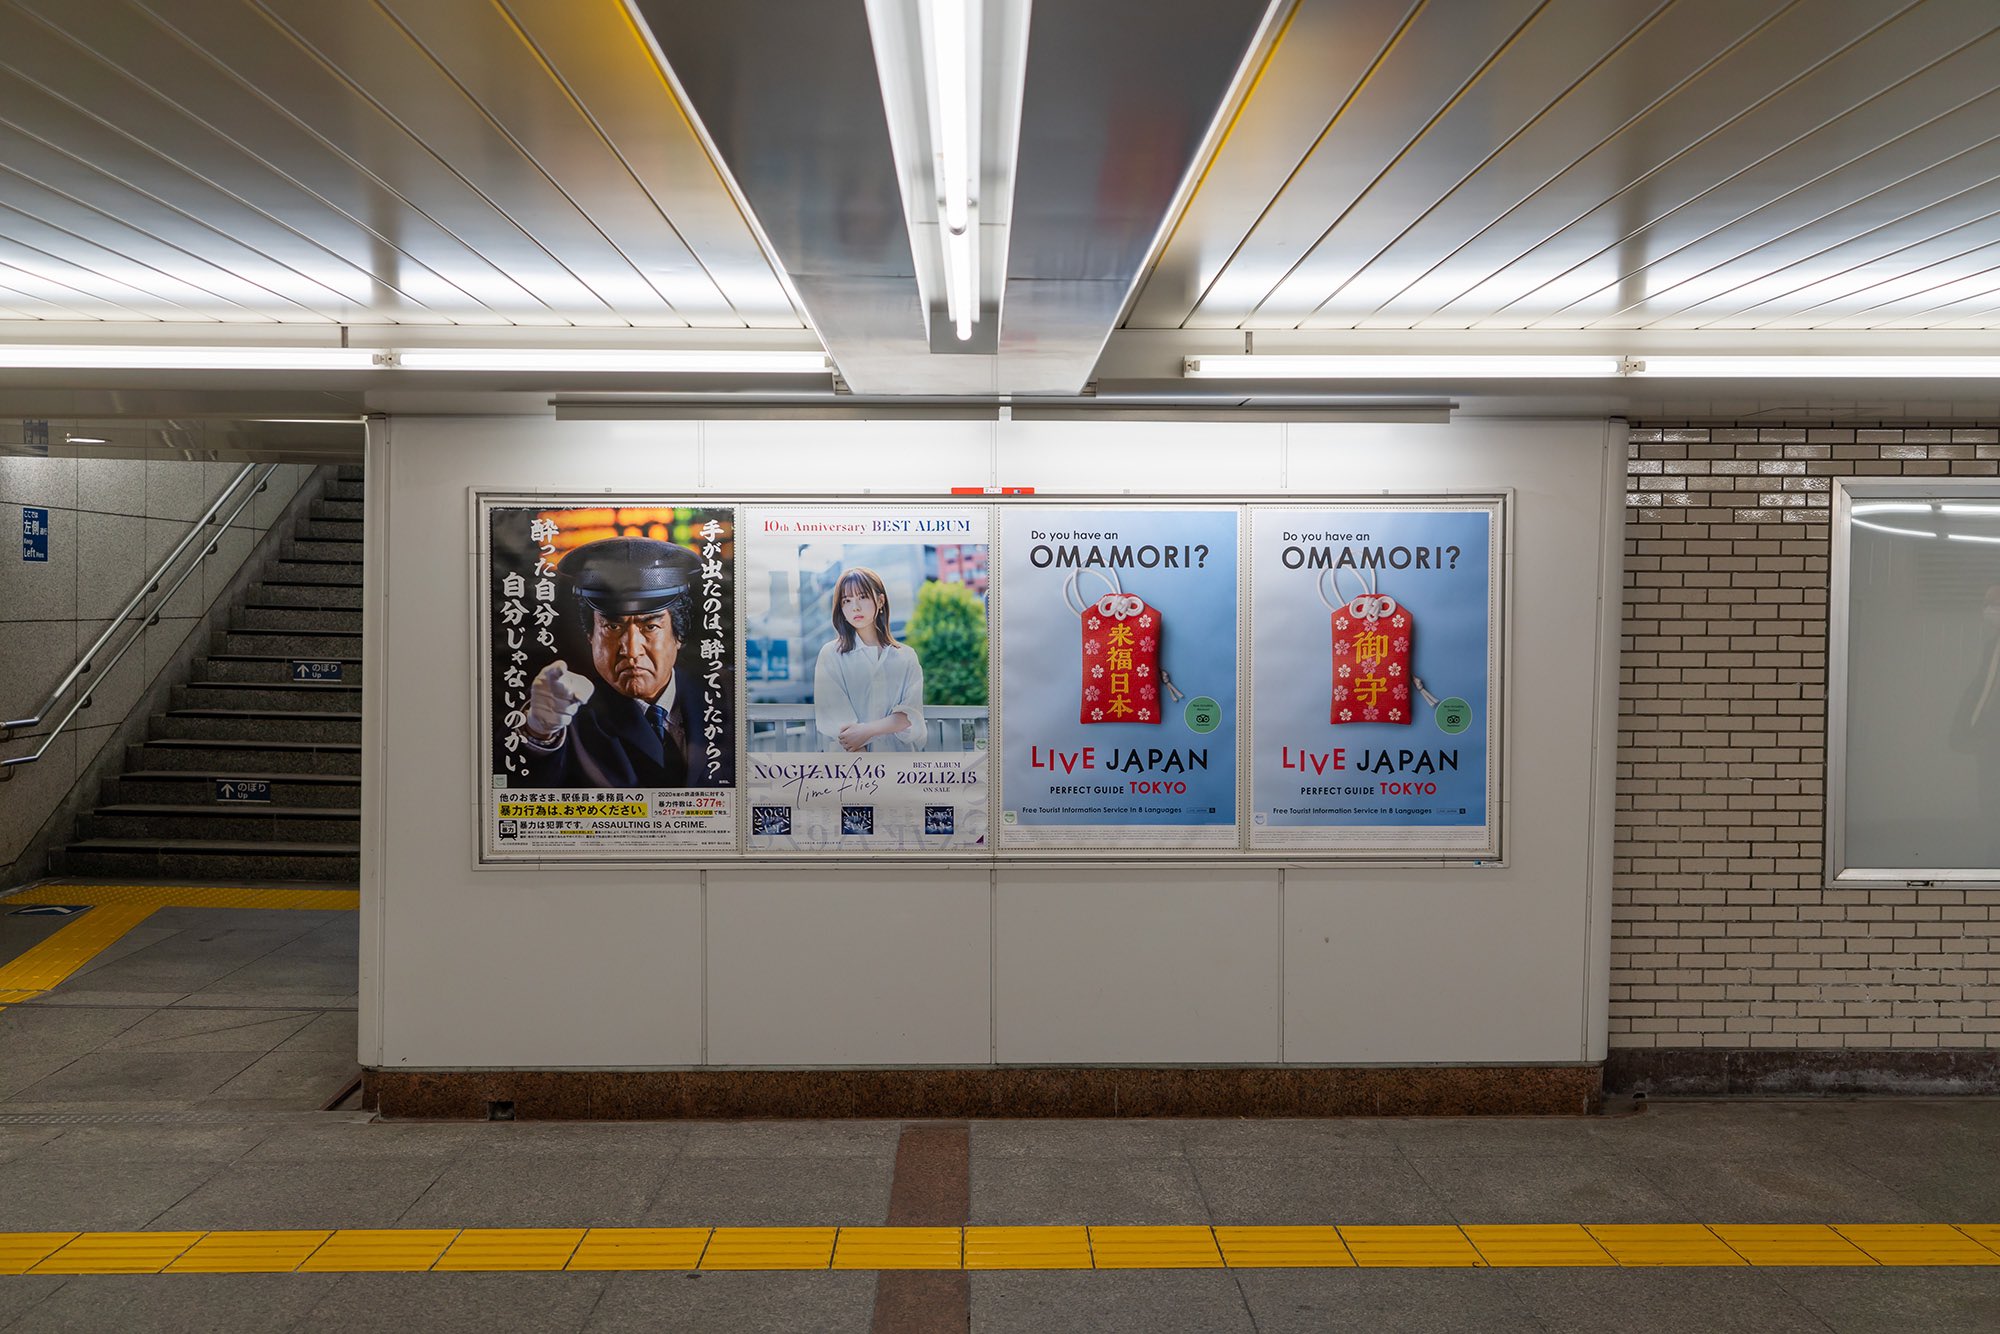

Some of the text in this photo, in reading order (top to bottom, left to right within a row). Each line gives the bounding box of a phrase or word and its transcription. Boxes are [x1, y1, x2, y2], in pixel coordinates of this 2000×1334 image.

[764, 520, 970, 535] 10th Anniversary BEST ALBUM
[1031, 530, 1118, 542] Do you have an
[1283, 531, 1370, 543] Do you have an
[24, 547, 36, 558] Left
[1030, 544, 1209, 569] OMAMORI?
[1281, 545, 1461, 570] OMAMORI?
[530, 518, 560, 654] 酔った自分も、
[312, 664, 338, 673] のぼり
[500, 571, 530, 777] 自分じゃないのかい。
[1107, 622, 1135, 718] 来福日本
[1352, 631, 1389, 707] 御守
[913, 761, 961, 769] BEST ALBUM
[1031, 746, 1208, 775] LIVE JAPAN
[1283, 746, 1458, 775] LIVE JAPAN
[896, 771, 977, 784] 2021.12.15
[237, 783, 266, 793] のぼり
[1050, 781, 1187, 795] PERFECT GUIDE TOKYO
[1300, 782, 1437, 796] PERFECT GUIDE TOKYO
[500, 805, 646, 816] 暴力行為は、おやめください。
[1145, 807, 1182, 815] Languages
[1395, 808, 1432, 816] Languages
[591, 821, 651, 829] ASSAULTING
[653, 821, 662, 829] IS
[664, 821, 672, 829] A
[674, 821, 708, 829] CRIME.
